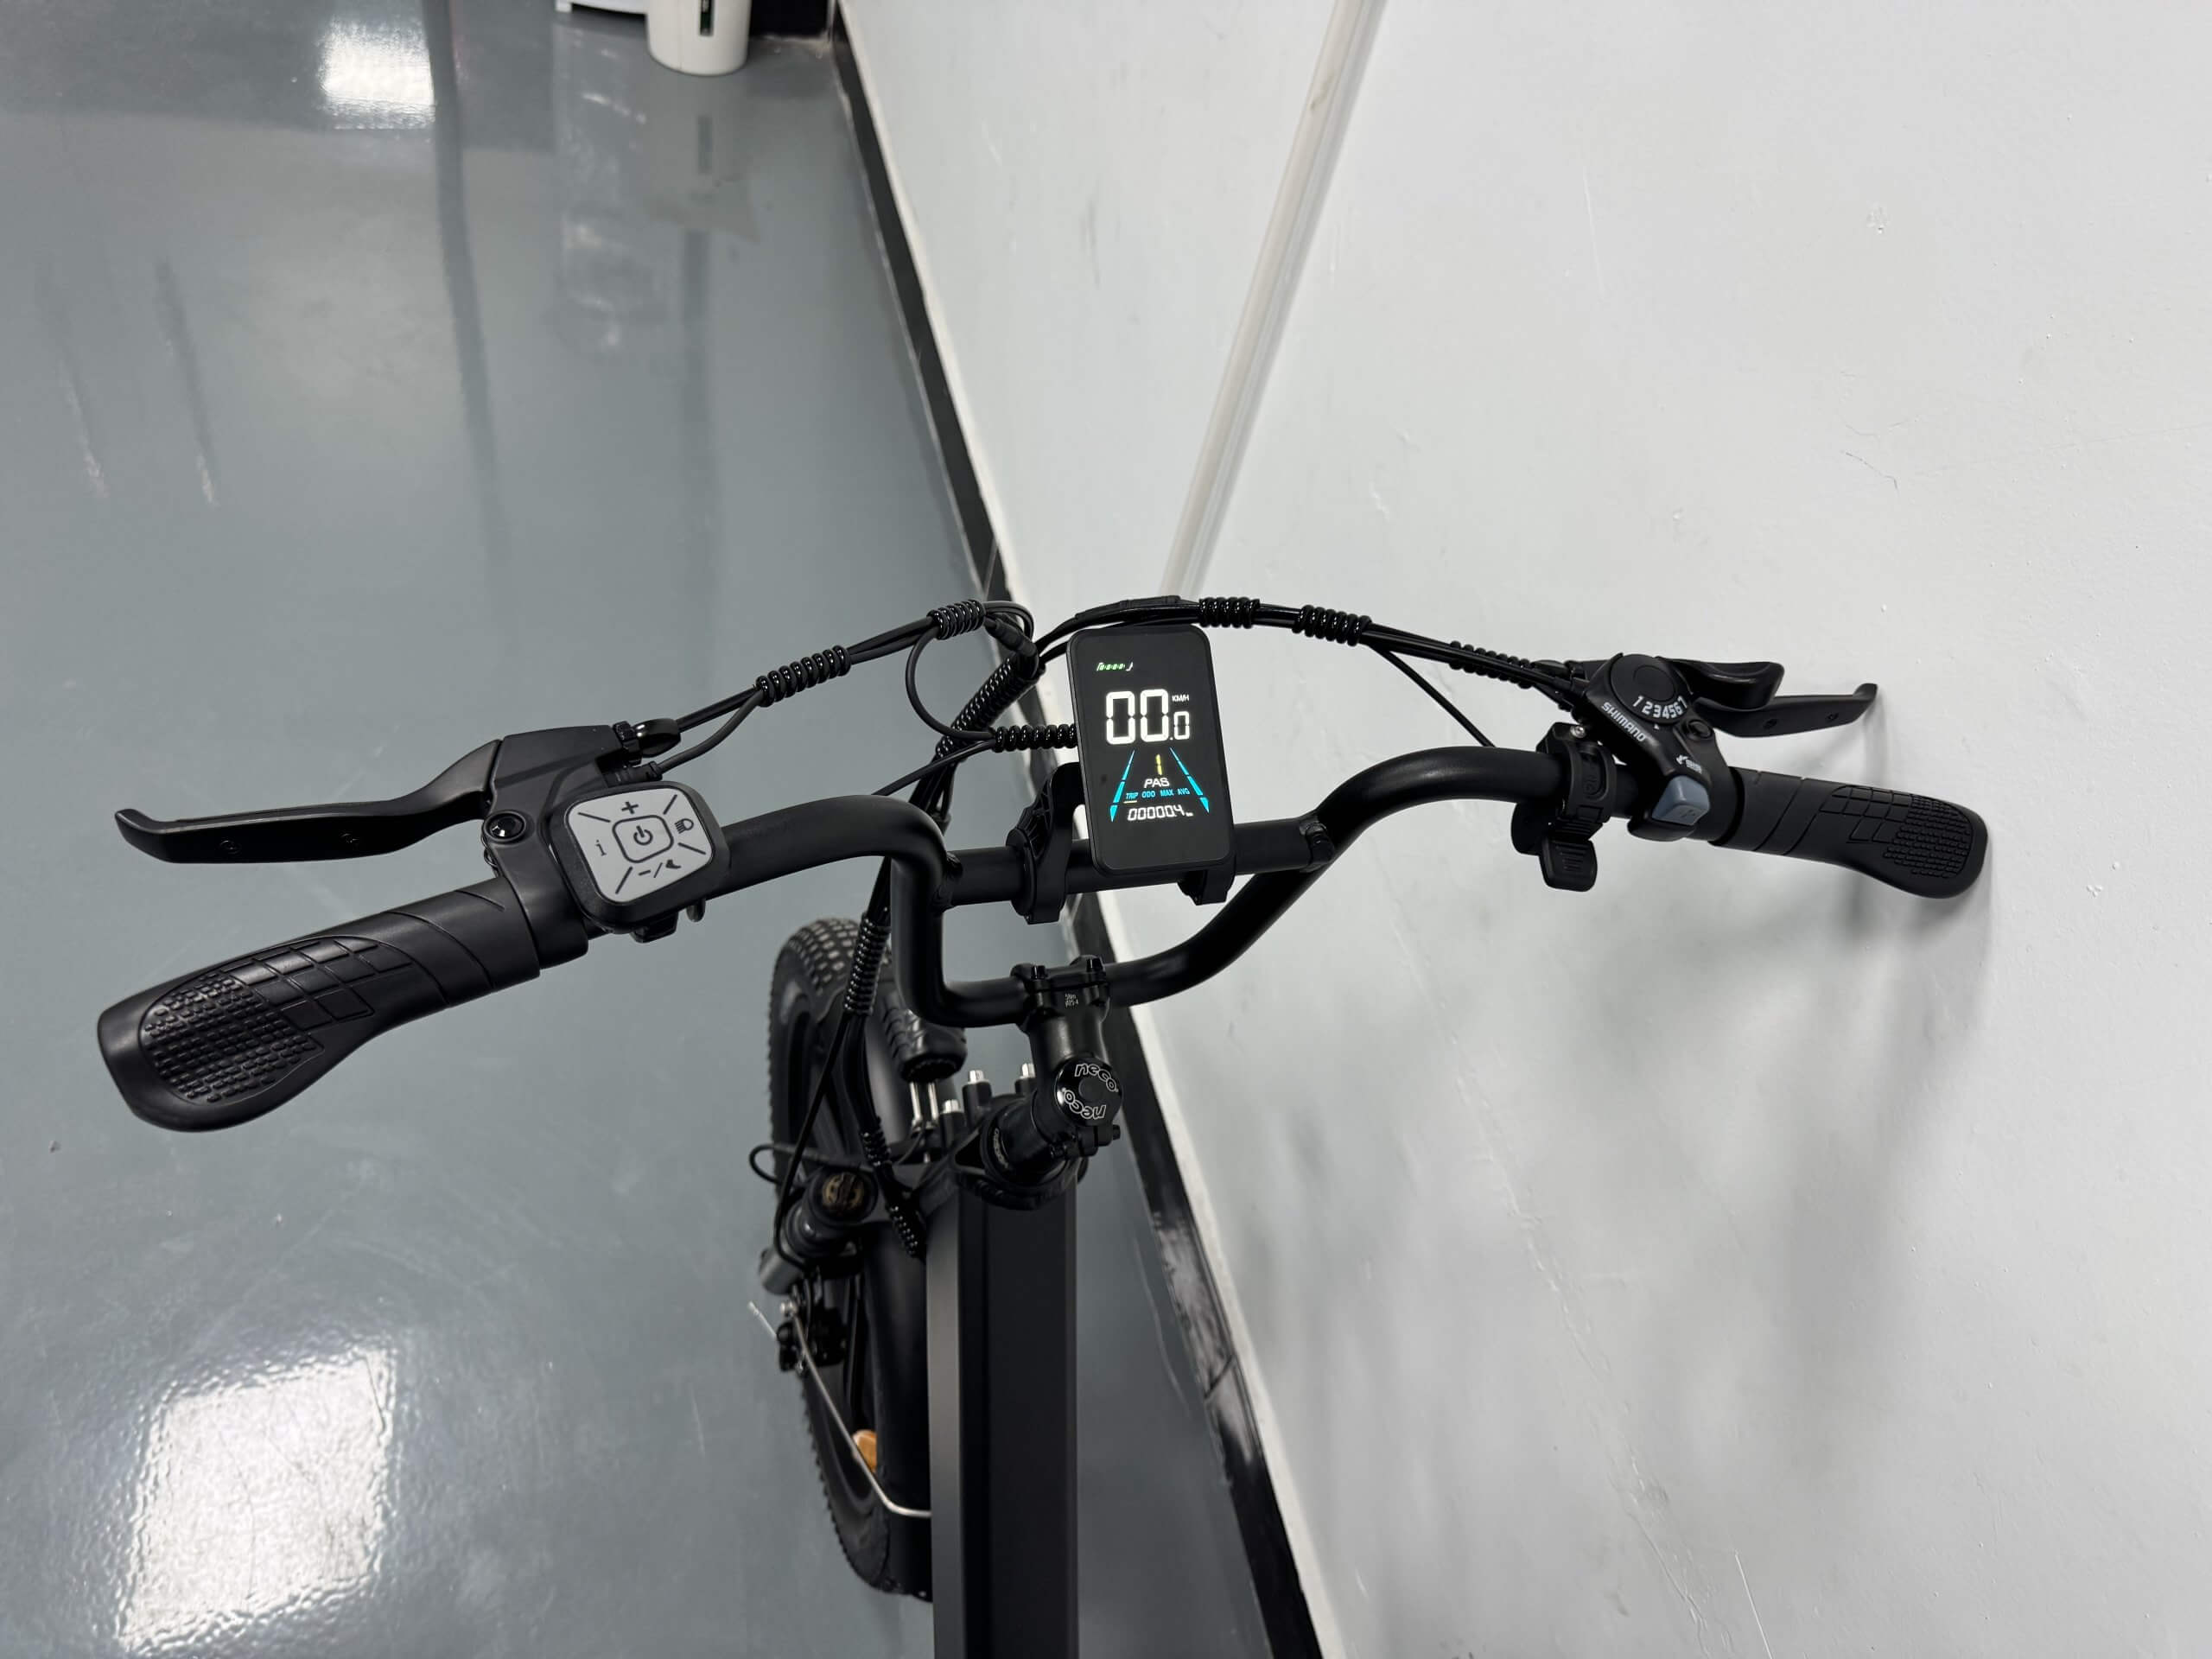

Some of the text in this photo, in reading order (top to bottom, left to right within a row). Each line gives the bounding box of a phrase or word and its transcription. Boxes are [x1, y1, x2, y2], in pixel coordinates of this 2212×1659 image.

[1171, 694, 1190, 702] KM/H
[1600, 702, 1647, 742] SHIMANO
[1144, 777, 1170, 788] PAS
[1141, 790, 1156, 798] ODO
[1160, 788, 1174, 797] MAX
[1074, 1063, 1117, 1092] neco
[1064, 1087, 1107, 1120] neco
